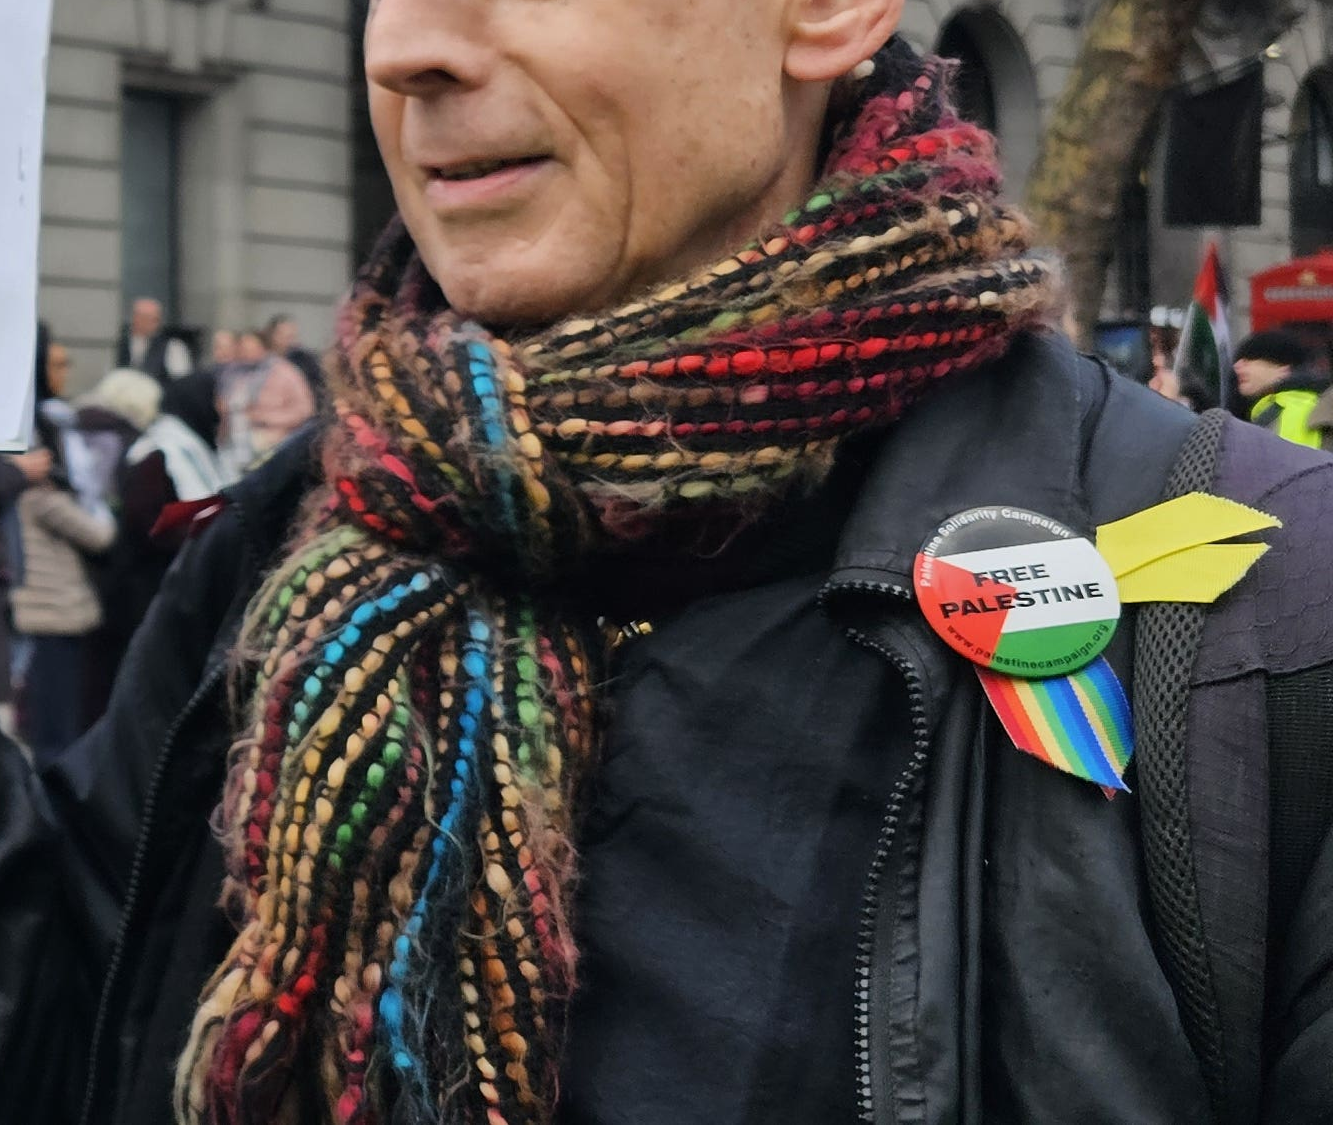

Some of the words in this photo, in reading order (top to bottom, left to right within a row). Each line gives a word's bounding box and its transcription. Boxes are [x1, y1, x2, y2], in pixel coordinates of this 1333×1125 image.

[920, 538, 942, 587] Palestine
[938, 509, 998, 539] Solidarity
[1001, 509, 1071, 539] Campaign
[972, 563, 1050, 588] FREE
[938, 582, 1103, 619] PALESTINE
[947, 623, 1110, 670] www.palestinecampaign.org
